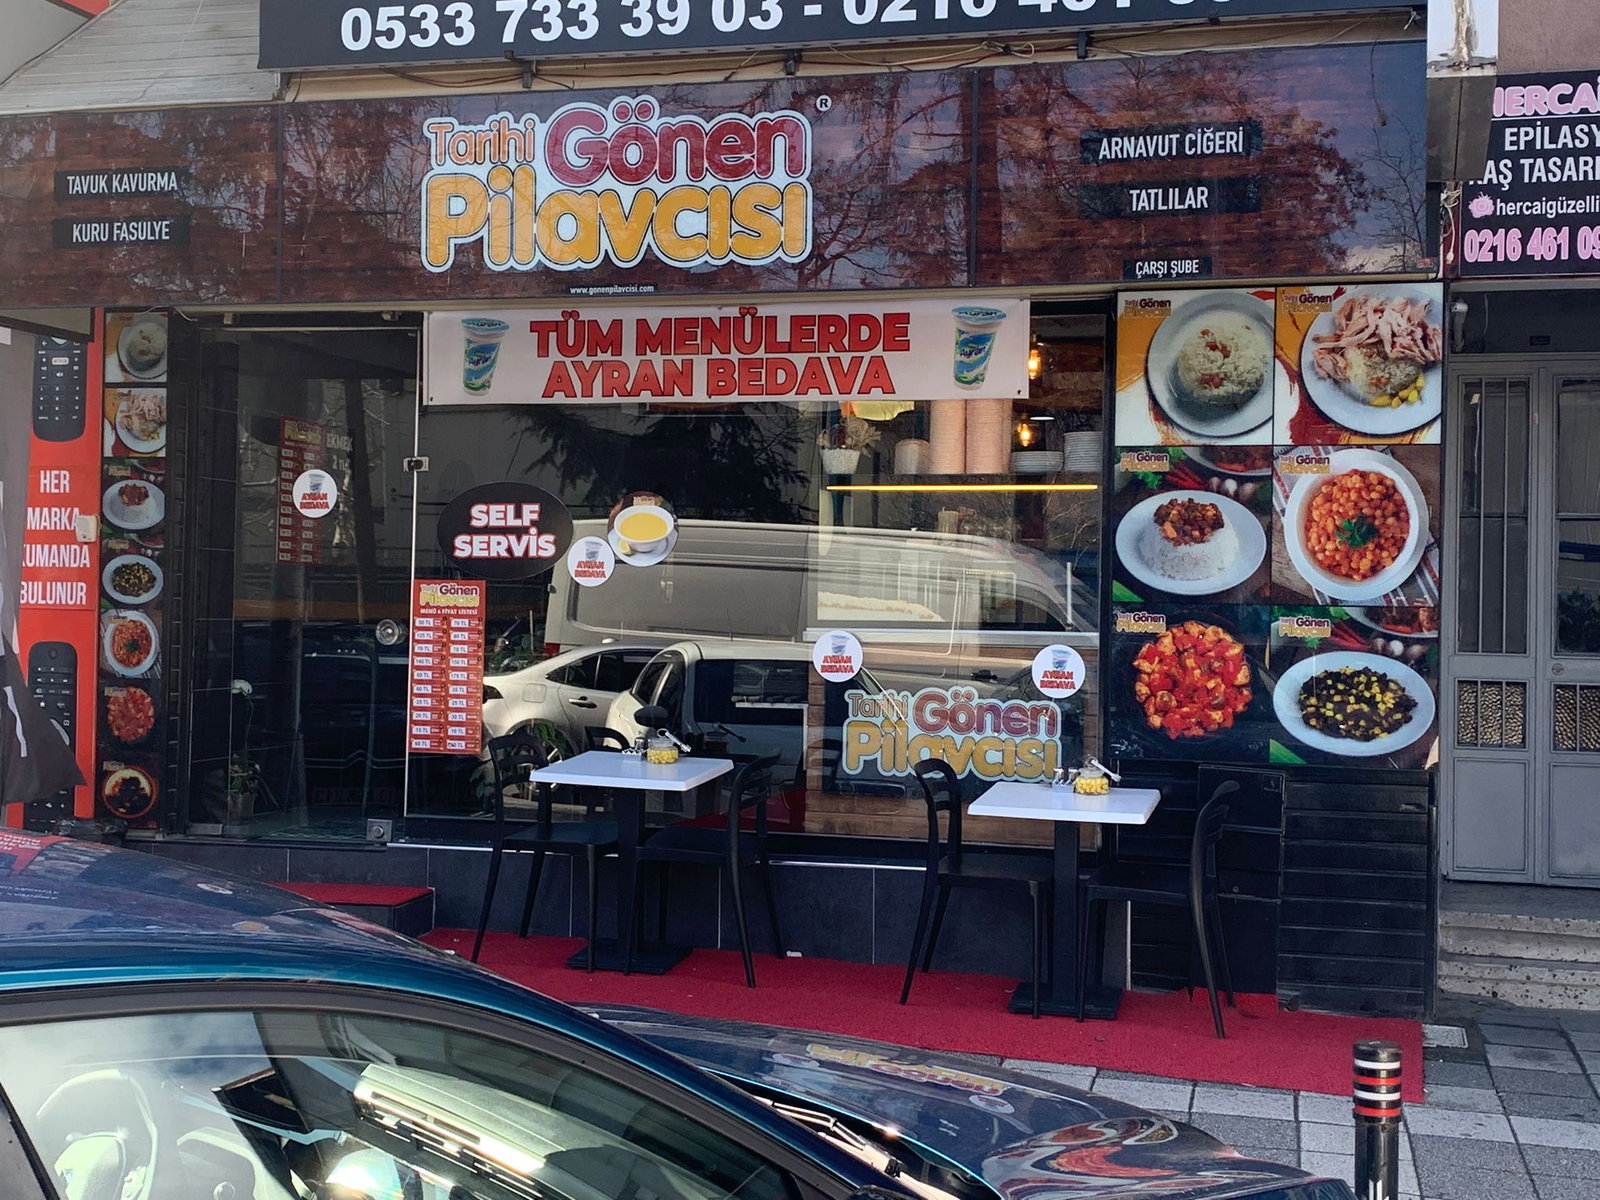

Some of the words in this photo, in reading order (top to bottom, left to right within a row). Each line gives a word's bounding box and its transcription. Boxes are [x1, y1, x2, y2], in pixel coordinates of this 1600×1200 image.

[341, 3, 476, 51] 0533
[495, 0, 600, 43] 733
[620, 0, 691, 37] 39
[711, 0, 783, 33] 03
[428, 116, 537, 166] Tarihi
[544, 101, 808, 188] Gönen
[1099, 133, 1180, 160] ARNAVUT
[1184, 126, 1244, 155] CİĞERİ
[67, 174, 108, 195] TAVUK
[112, 171, 178, 193] KAVURMA
[1469, 159, 1513, 190] AŞ
[1129, 186, 1209, 212] TATLILAR
[72, 222, 109, 243] KURU
[113, 221, 170, 242] FASULYE
[1463, 228, 1522, 263] 0216
[1526, 226, 1570, 261] 461
[1135, 260, 1168, 279] ÇARŞI
[1171, 259, 1200, 277] ŞUBE
[569, 284, 655, 296] www.gonenpilavcisi.com
[529, 310, 623, 358] TÜM
[635, 306, 911, 356] MENÜLERDE
[541, 358, 694, 399] AYRAN
[706, 355, 897, 396] BEDAVA
[1136, 451, 1168, 462] Gönen
[1295, 454, 1330, 465] Gönen
[39, 470, 71, 494] HER
[469, 502, 541, 528] SELF
[452, 525, 557, 558] SERVİS
[439, 584, 479, 596] Gönen
[1132, 611, 1165, 623] Gönen
[1295, 616, 1330, 628] Gönen
[848, 692, 909, 718] Tarihi
[912, 690, 1057, 738] Gönen
